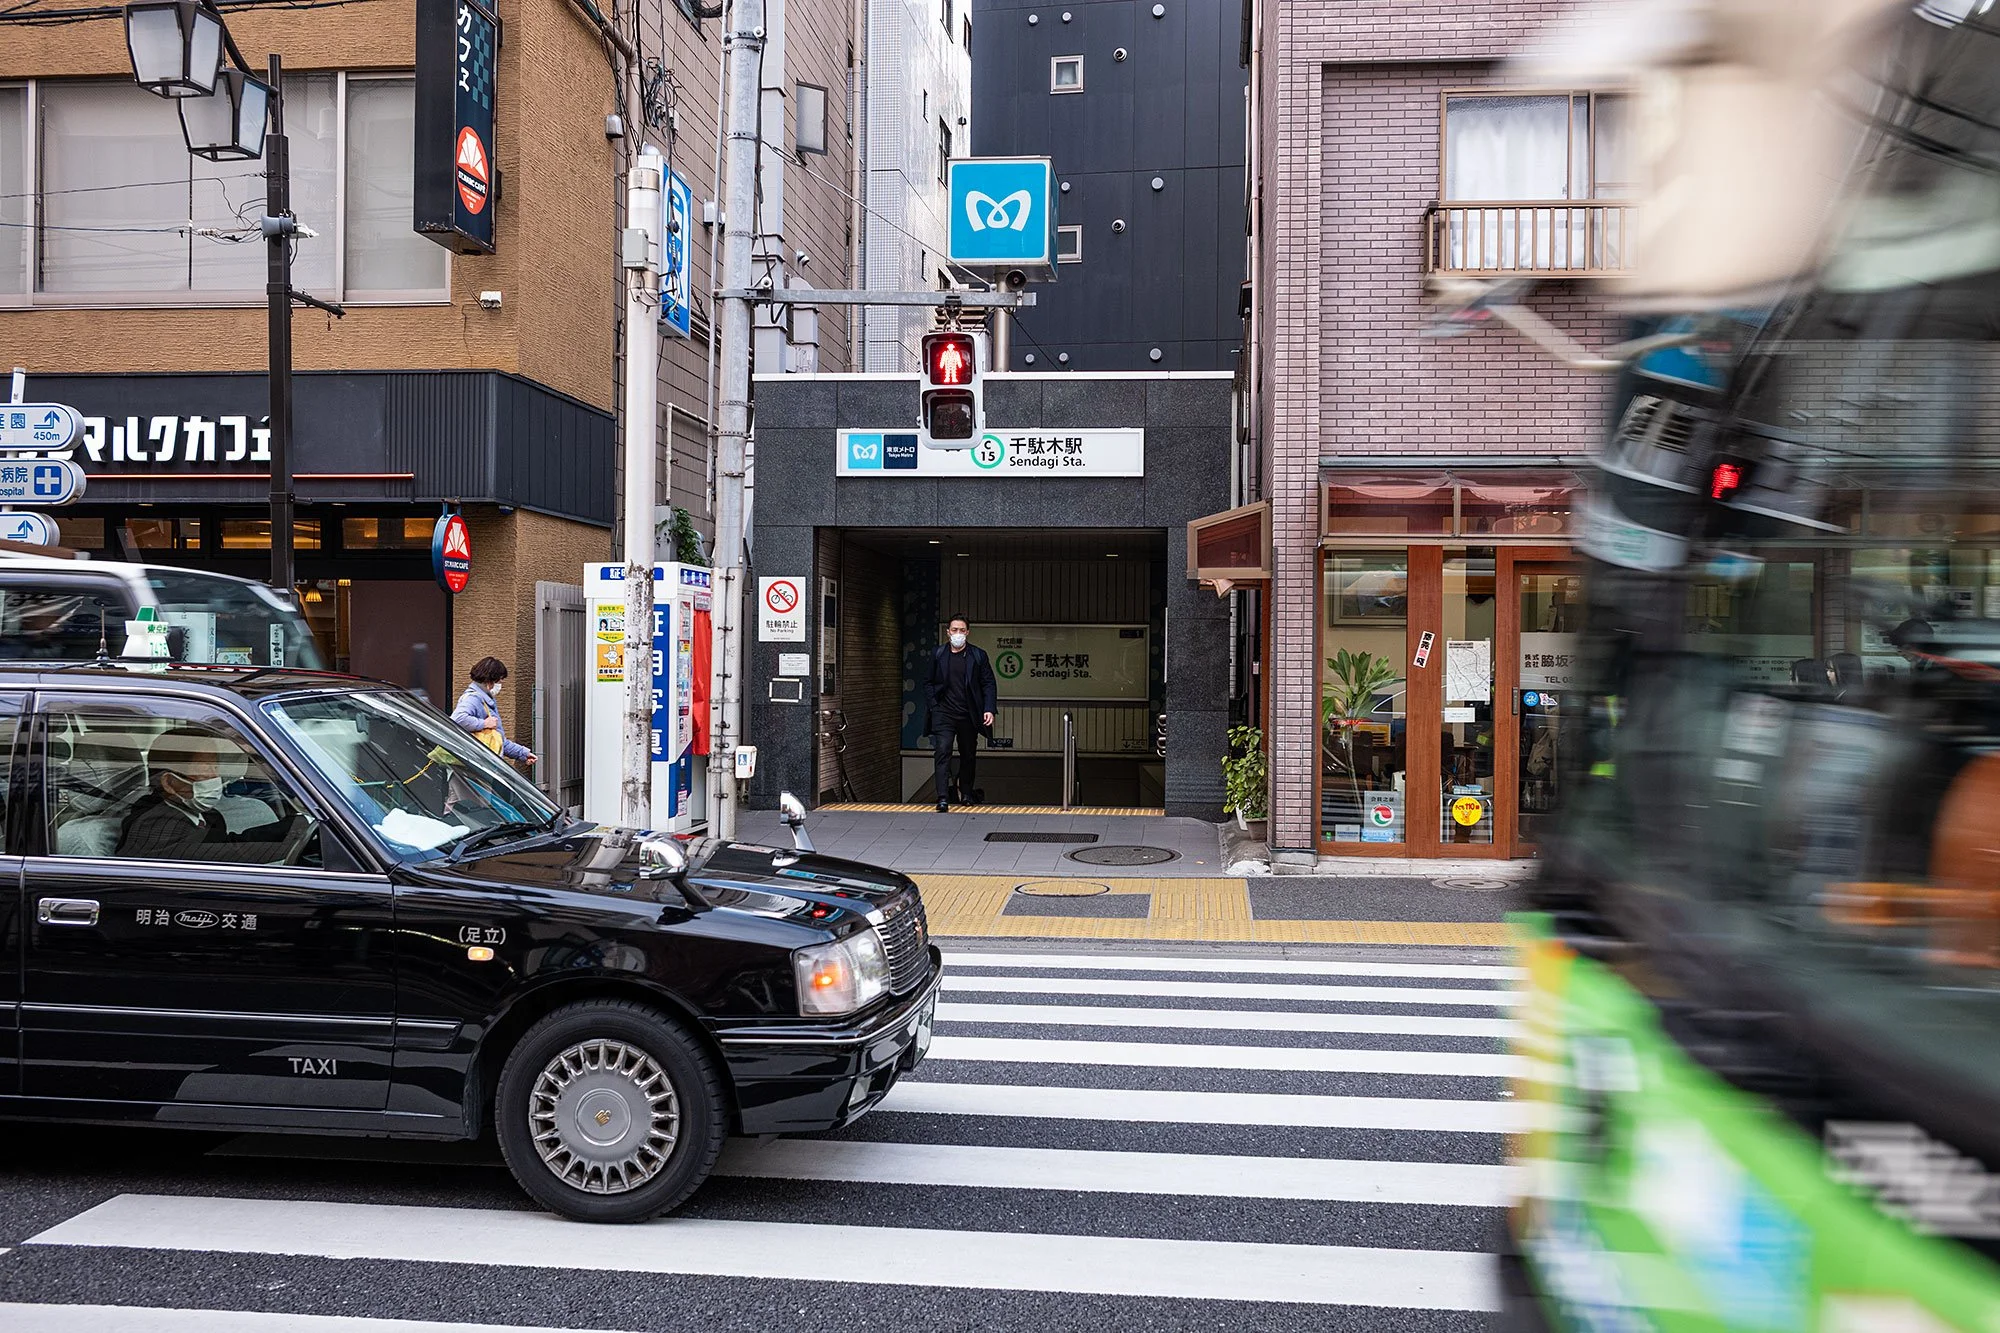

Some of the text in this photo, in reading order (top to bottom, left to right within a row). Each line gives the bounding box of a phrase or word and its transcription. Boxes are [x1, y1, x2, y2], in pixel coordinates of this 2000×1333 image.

[33, 431, 60, 441] 450m
[984, 440, 992, 450] C
[1009, 437, 1082, 456] 千駄木駅
[980, 451, 996, 462] 15
[1009, 456, 1086, 470] Sendagi Sta.
[766, 620, 799, 629] 駐輪禁止
[1006, 655, 1013, 664] C
[1030, 653, 1090, 668] 千駄木駅
[1004, 664, 1016, 673] 15
[1030, 668, 1092, 680] Sendagi Sta.
[1544, 676, 1561, 684] TEL
[135, 909, 171, 926] 明治
[221, 912, 258, 930] 交通
[458, 925, 507, 944] (足立)
[288, 1057, 338, 1075] TAXI
